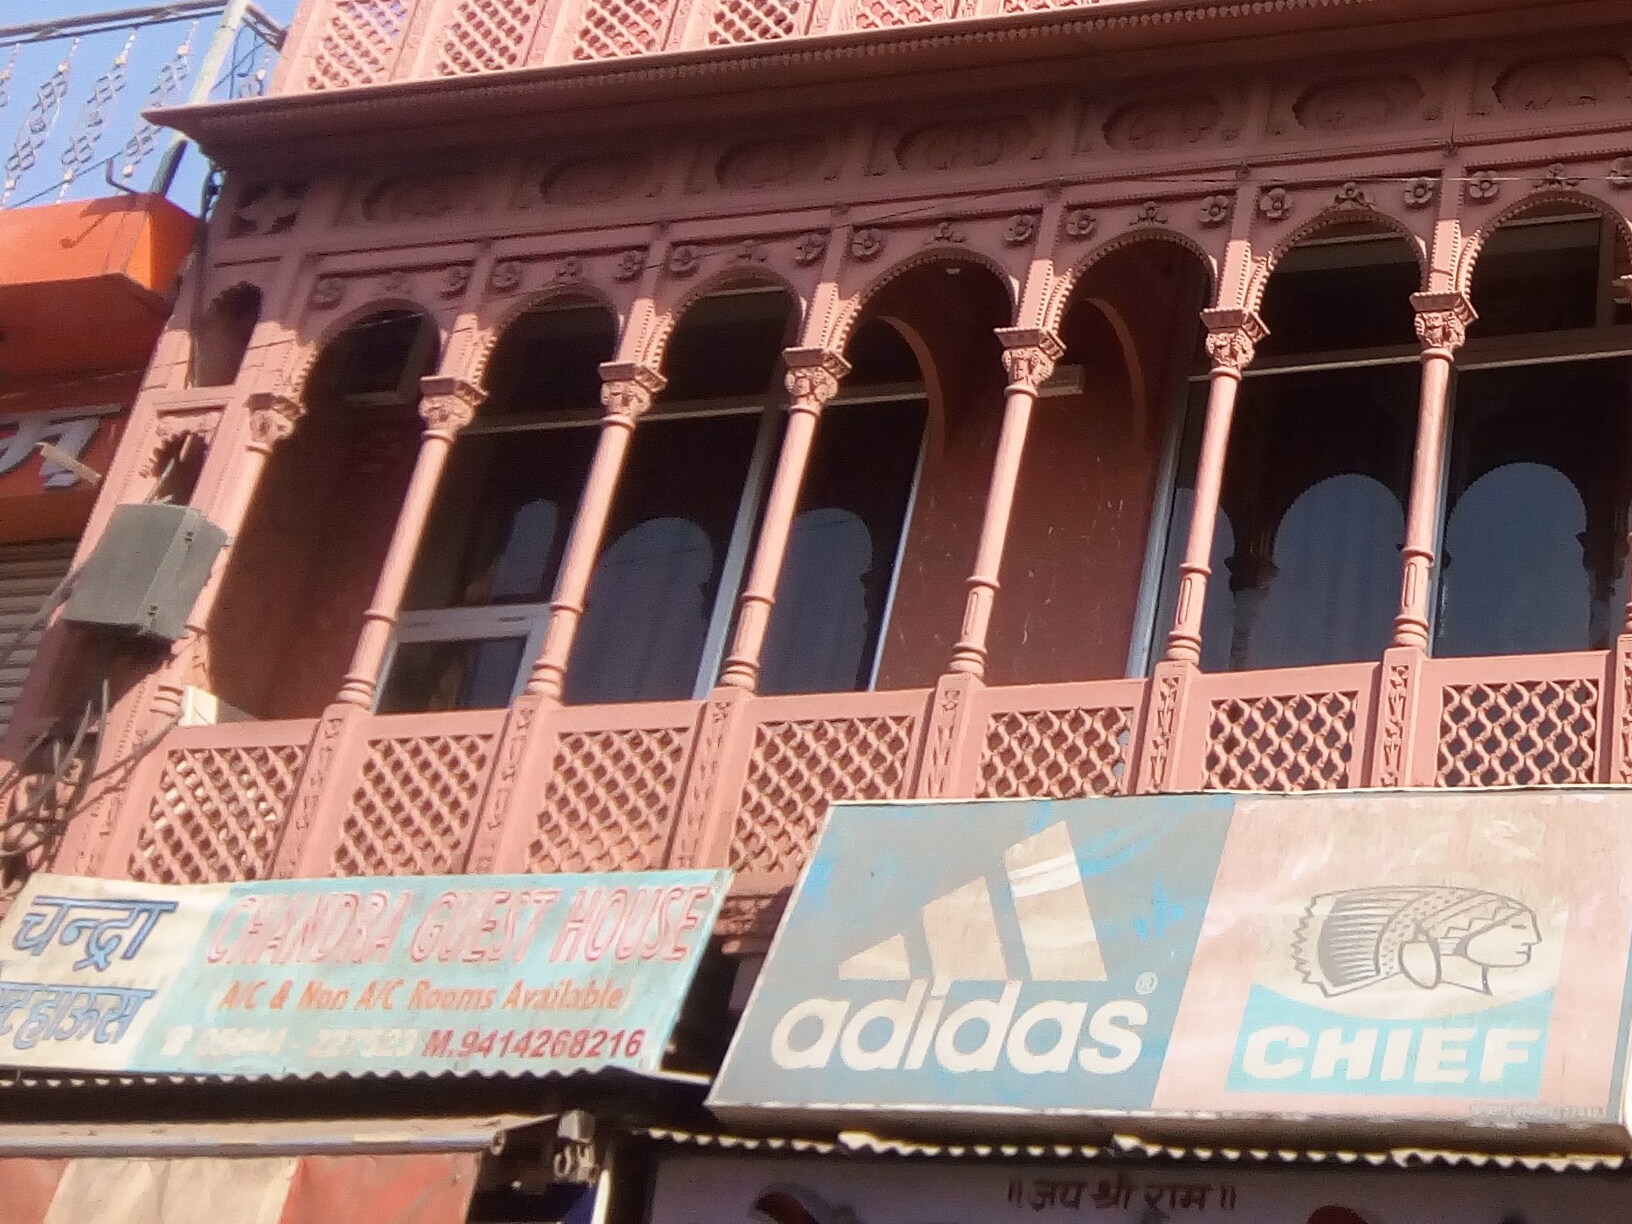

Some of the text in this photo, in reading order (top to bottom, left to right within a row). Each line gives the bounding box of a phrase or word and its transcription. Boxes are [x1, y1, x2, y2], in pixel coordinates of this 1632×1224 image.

[12, 894, 179, 973] चन्द्रा
[207, 884, 711, 965] CHANDRA GUEST HOUSE
[297, 979, 349, 1011] Non
[407, 978, 499, 1011] Rooms
[501, 978, 625, 1012] Available
[770, 978, 1149, 1074] adidas
[421, 1028, 647, 1059] M.9414268216
[1241, 1025, 1542, 1084] CHIEF
